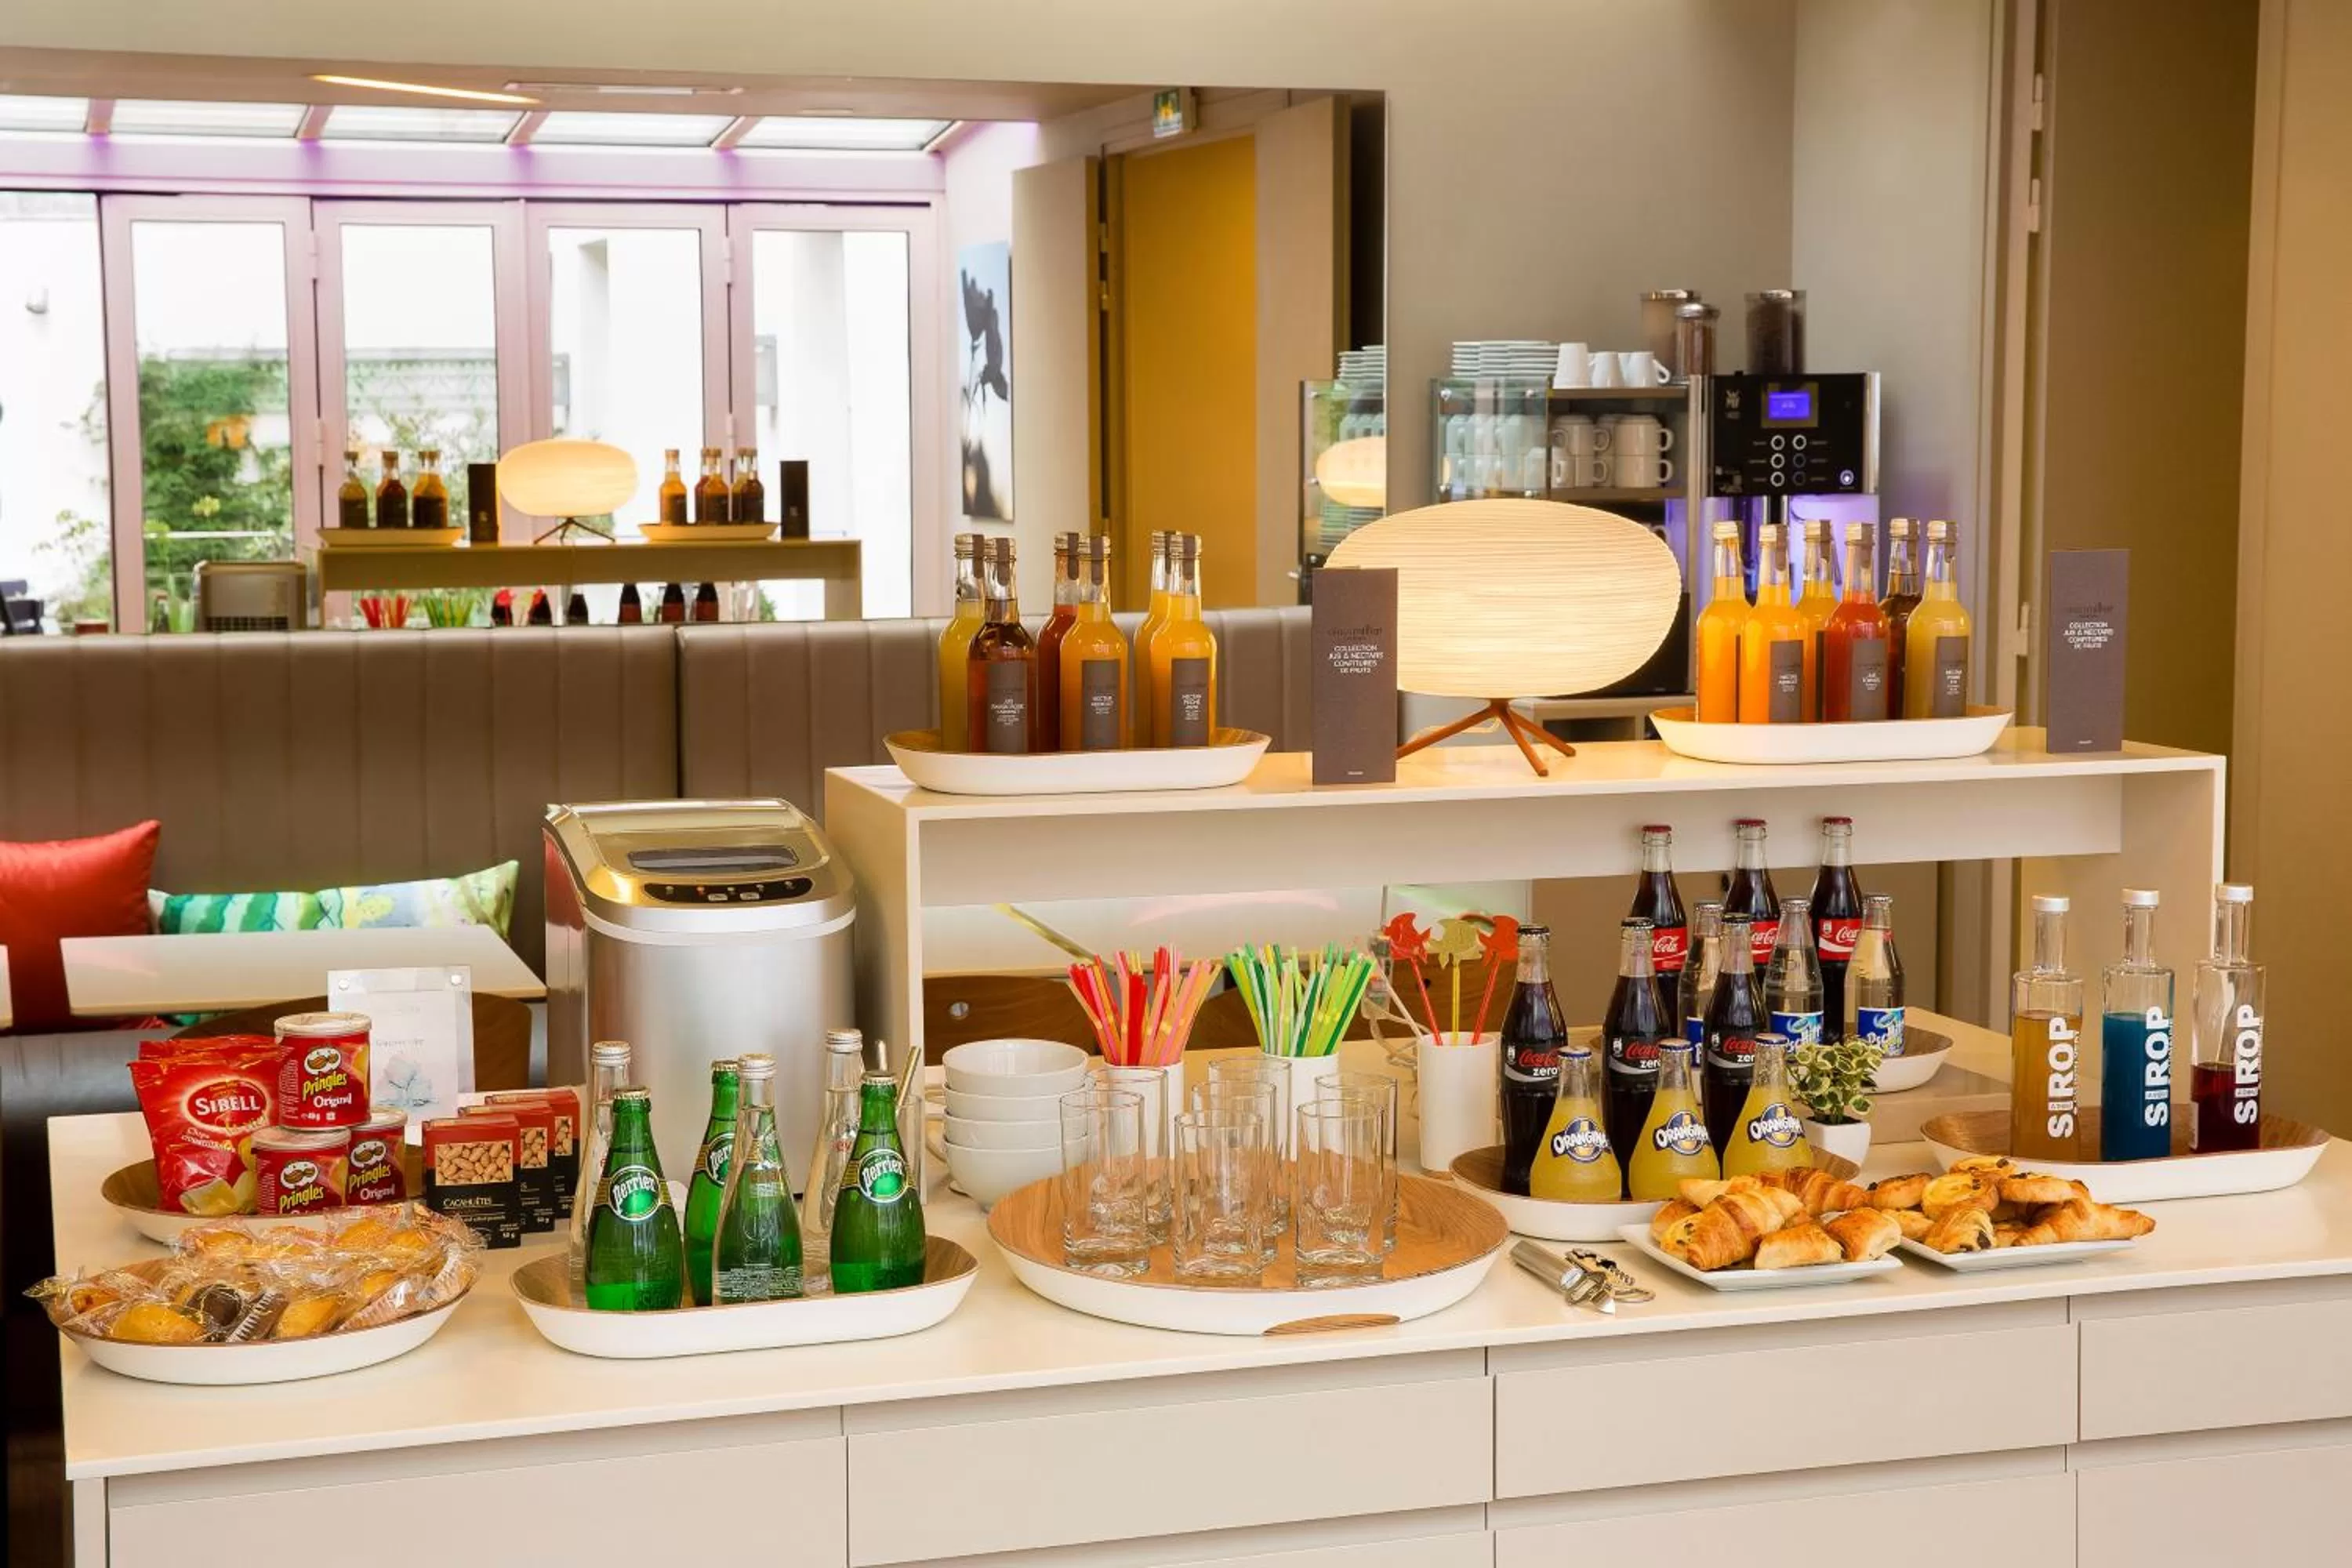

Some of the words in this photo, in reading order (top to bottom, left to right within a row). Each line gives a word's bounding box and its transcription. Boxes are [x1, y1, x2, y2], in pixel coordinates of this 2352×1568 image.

[1533, 1067, 1558, 1076] zero
[2047, 1017, 2074, 1138] SIROP
[2145, 1006, 2170, 1127] SIROP
[2234, 1004, 2263, 1124] SIROP
[303, 1071, 347, 1102] Pringles
[314, 1092, 352, 1108] Original
[1553, 1130, 1609, 1154] ORANGINA
[1656, 1123, 1710, 1148] ORANGINA
[1750, 1115, 1805, 1140] ORANGINA
[349, 1163, 391, 1193] Pringles
[279, 1184, 325, 1214] Pringles
